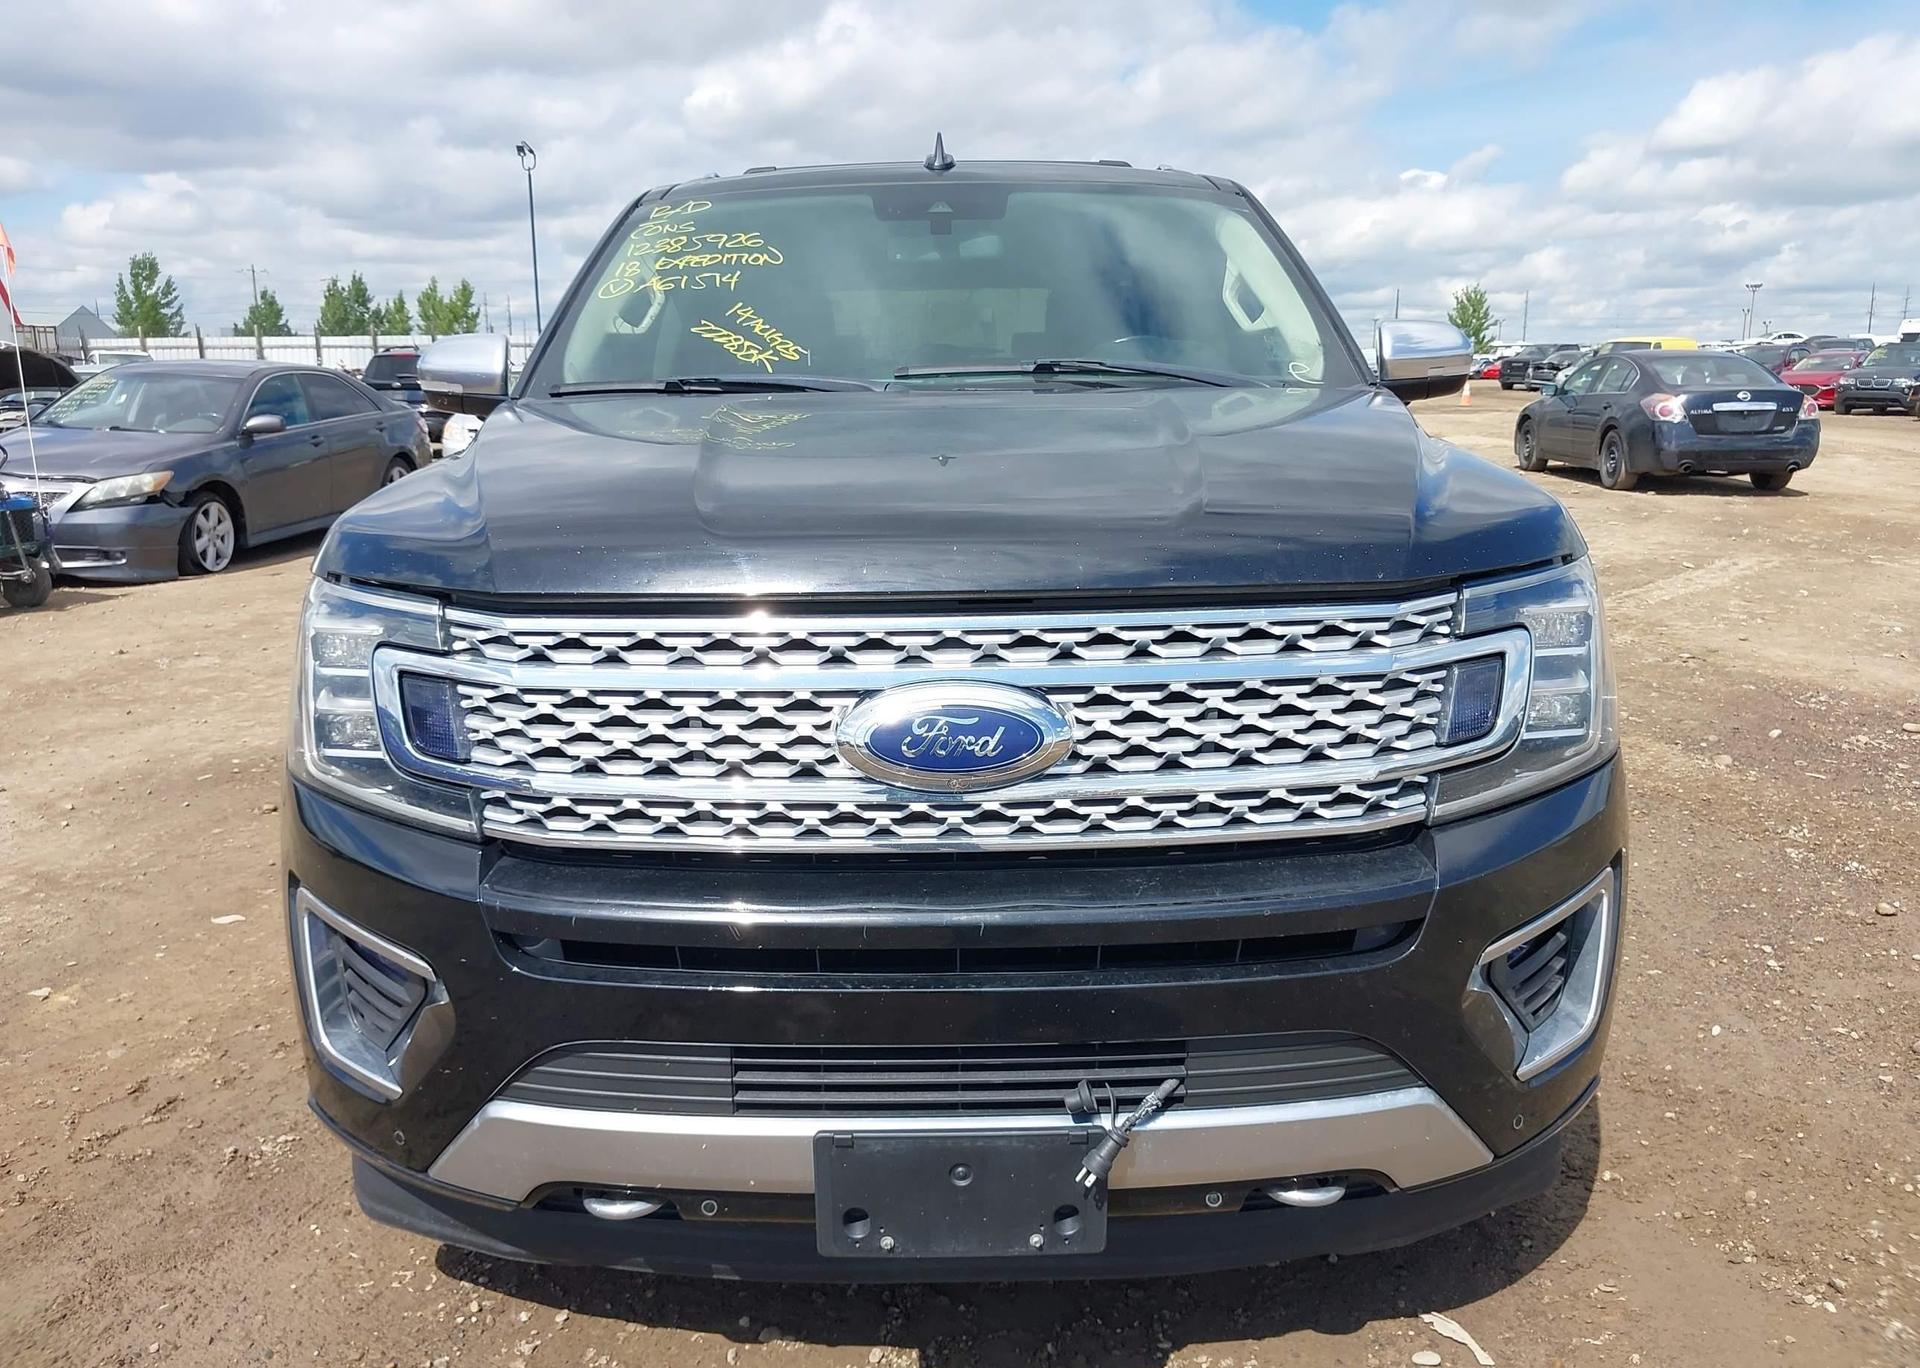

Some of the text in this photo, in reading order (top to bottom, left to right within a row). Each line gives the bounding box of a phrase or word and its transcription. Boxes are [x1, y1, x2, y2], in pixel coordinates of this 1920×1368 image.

[615, 247, 784, 277] 18 EXPEDITION
[901, 715, 1004, 758] Ford
